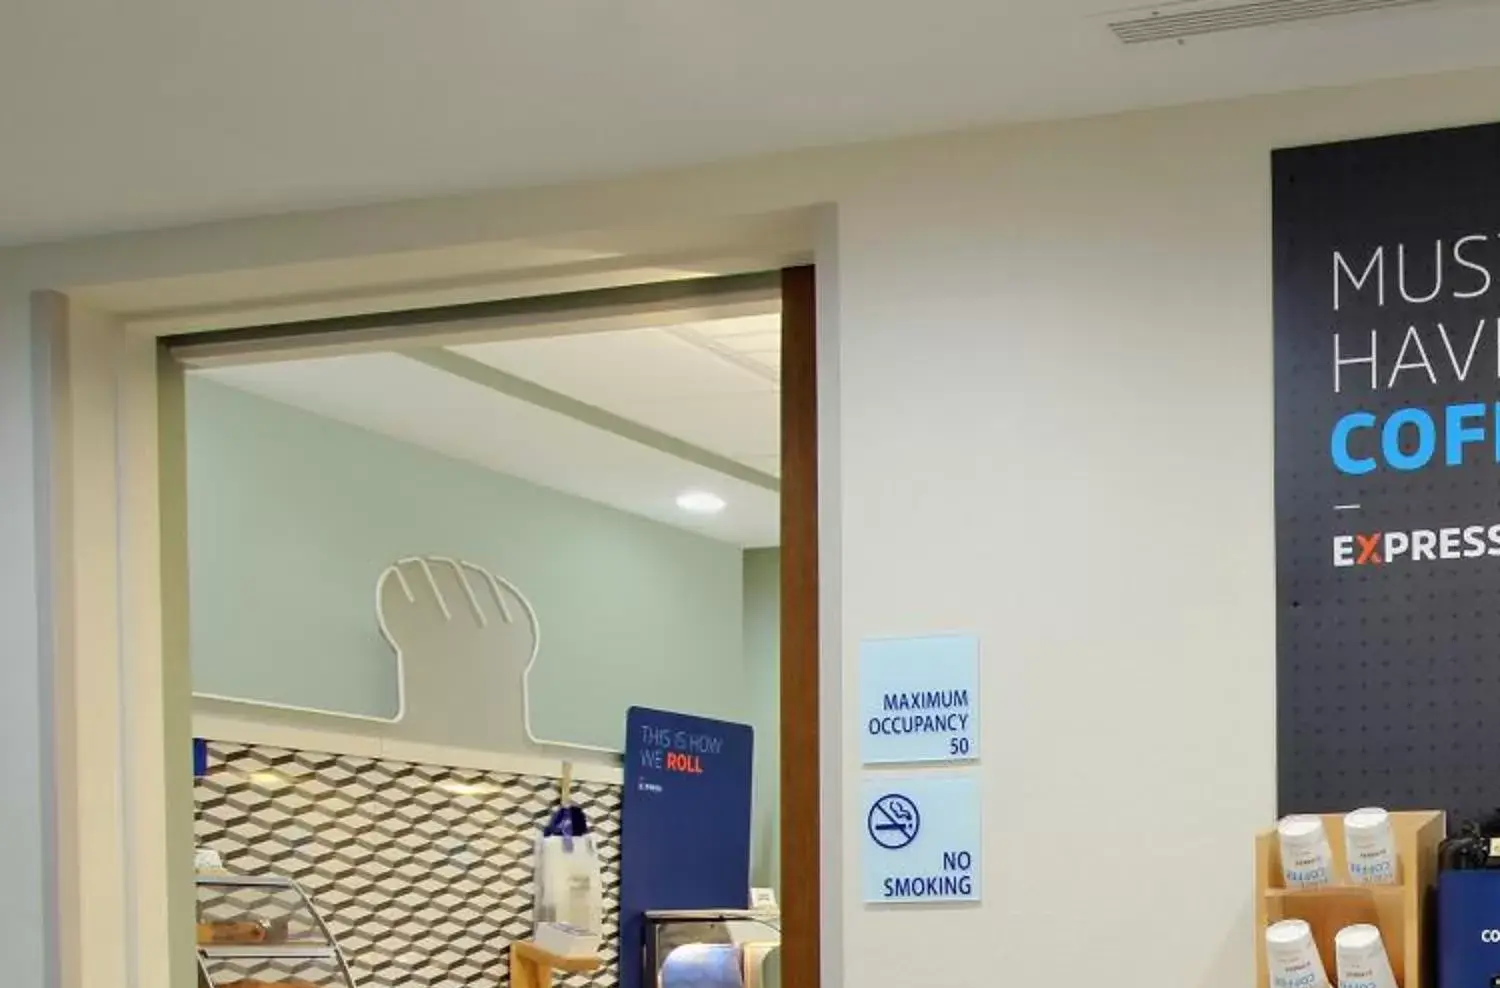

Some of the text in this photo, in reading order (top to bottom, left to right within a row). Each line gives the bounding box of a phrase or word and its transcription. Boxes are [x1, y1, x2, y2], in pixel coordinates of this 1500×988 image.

[882, 689, 969, 711] MAXIMUM
[868, 713, 969, 735] OCCUPANCY
[641, 725, 723, 754] THIS IS HOW
[949, 737, 969, 755] 50
[640, 748, 704, 774] WE ROLL
[942, 850, 971, 871] NO
[883, 875, 972, 897] SMOKING
